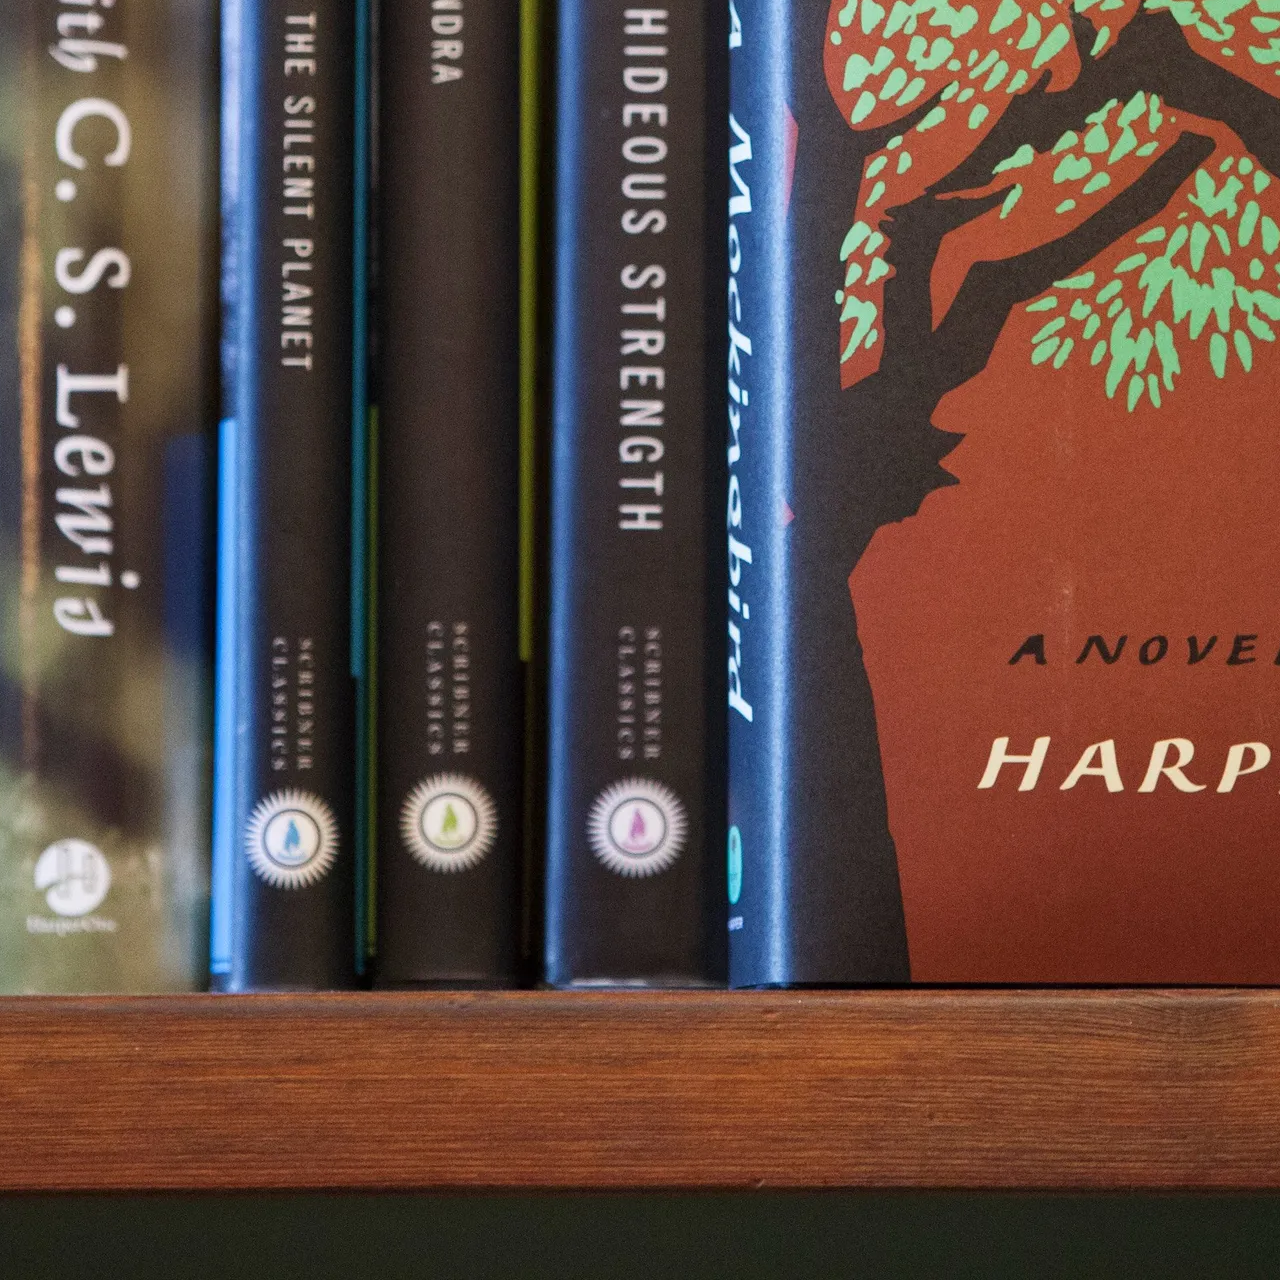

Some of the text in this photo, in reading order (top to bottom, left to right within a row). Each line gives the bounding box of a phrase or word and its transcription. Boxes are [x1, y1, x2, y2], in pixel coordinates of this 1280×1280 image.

[283, 12, 318, 78] THE
[55, 97, 132, 203] C.
[282, 95, 316, 220] SILENT
[622, 8, 668, 235] HIDEOUS
[54, 247, 132, 329] S.
[279, 237, 314, 371] PLANET
[619, 263, 667, 531] STRENGTH
[54, 363, 140, 637] Lewis
[1008, 634, 1047, 665] A
